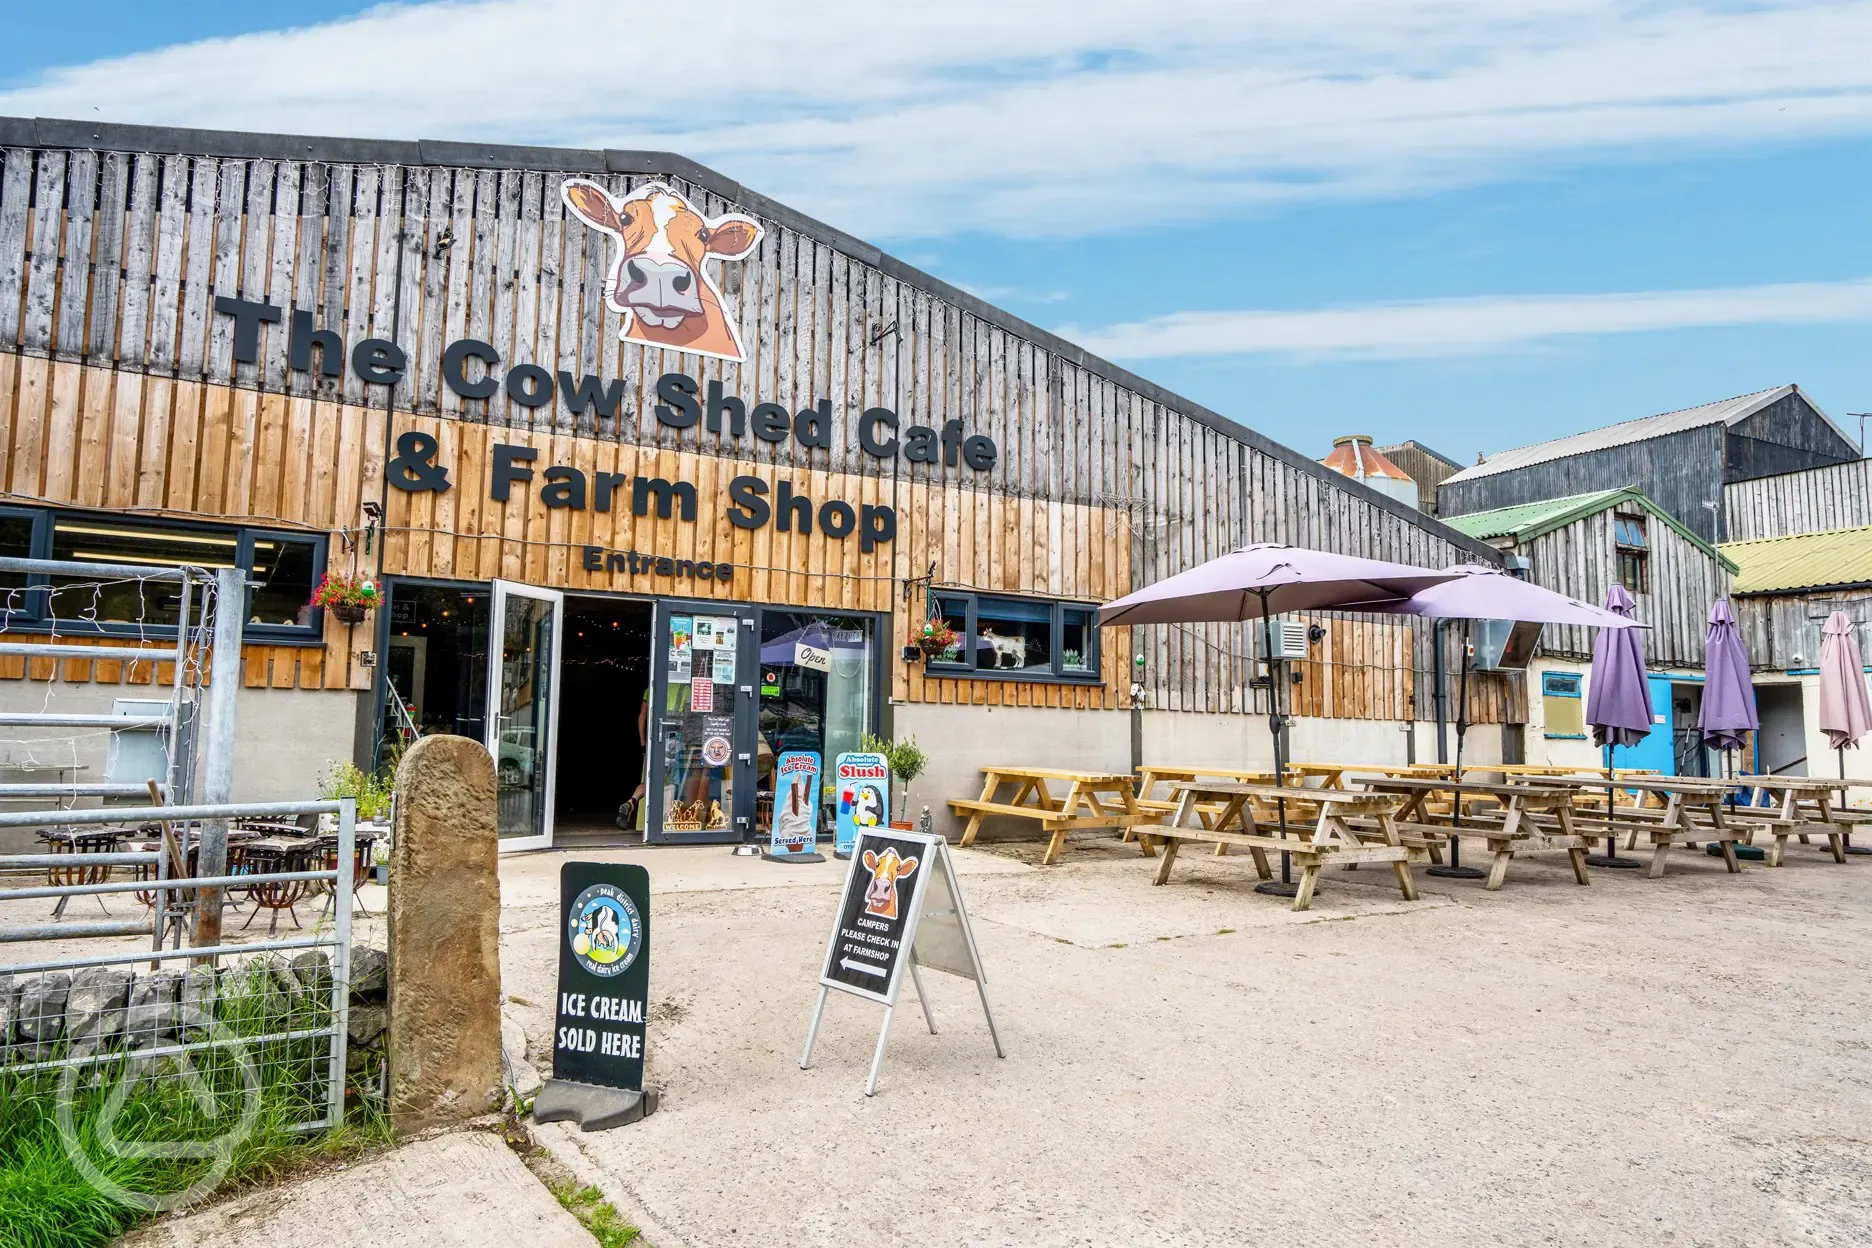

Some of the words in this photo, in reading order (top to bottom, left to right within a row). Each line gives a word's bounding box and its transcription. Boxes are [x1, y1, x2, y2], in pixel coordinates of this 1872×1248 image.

[215, 296, 407, 385] The
[443, 339, 627, 418] Cow
[654, 373, 833, 449] Shed
[859, 407, 998, 472] Cafe
[385, 431, 452, 493] &
[491, 443, 697, 522] Farm
[727, 475, 897, 553] Shop
[583, 545, 735, 581] Entrance
[800, 647, 827, 665] Open
[780, 765, 792, 774] Ice
[794, 762, 817, 773] Cream
[786, 755, 814, 765] Absolute
[845, 755, 879, 763] Absolute
[839, 764, 886, 778] Slush
[664, 823, 700, 831] WELCOME
[774, 836, 797, 845] Served
[798, 835, 813, 843] Here
[600, 887, 615, 897] peak
[616, 893, 635, 915] district
[631, 918, 641, 938] dairy
[857, 917, 890, 932] CAMPERS
[841, 928, 866, 942] PLEASE
[866, 934, 890, 948] CHECK
[891, 939, 900, 949] IN
[843, 943, 852, 952] AT
[852, 945, 890, 961] FARMSHOP
[586, 960, 597, 971] real
[596, 964, 611, 976] dairy
[611, 963, 620, 973] ice
[619, 952, 634, 969] cream
[561, 992, 586, 1017] ICE
[590, 995, 642, 1024] CREAM
[558, 1026, 597, 1052] SOLD
[601, 1032, 641, 1059] HERE
